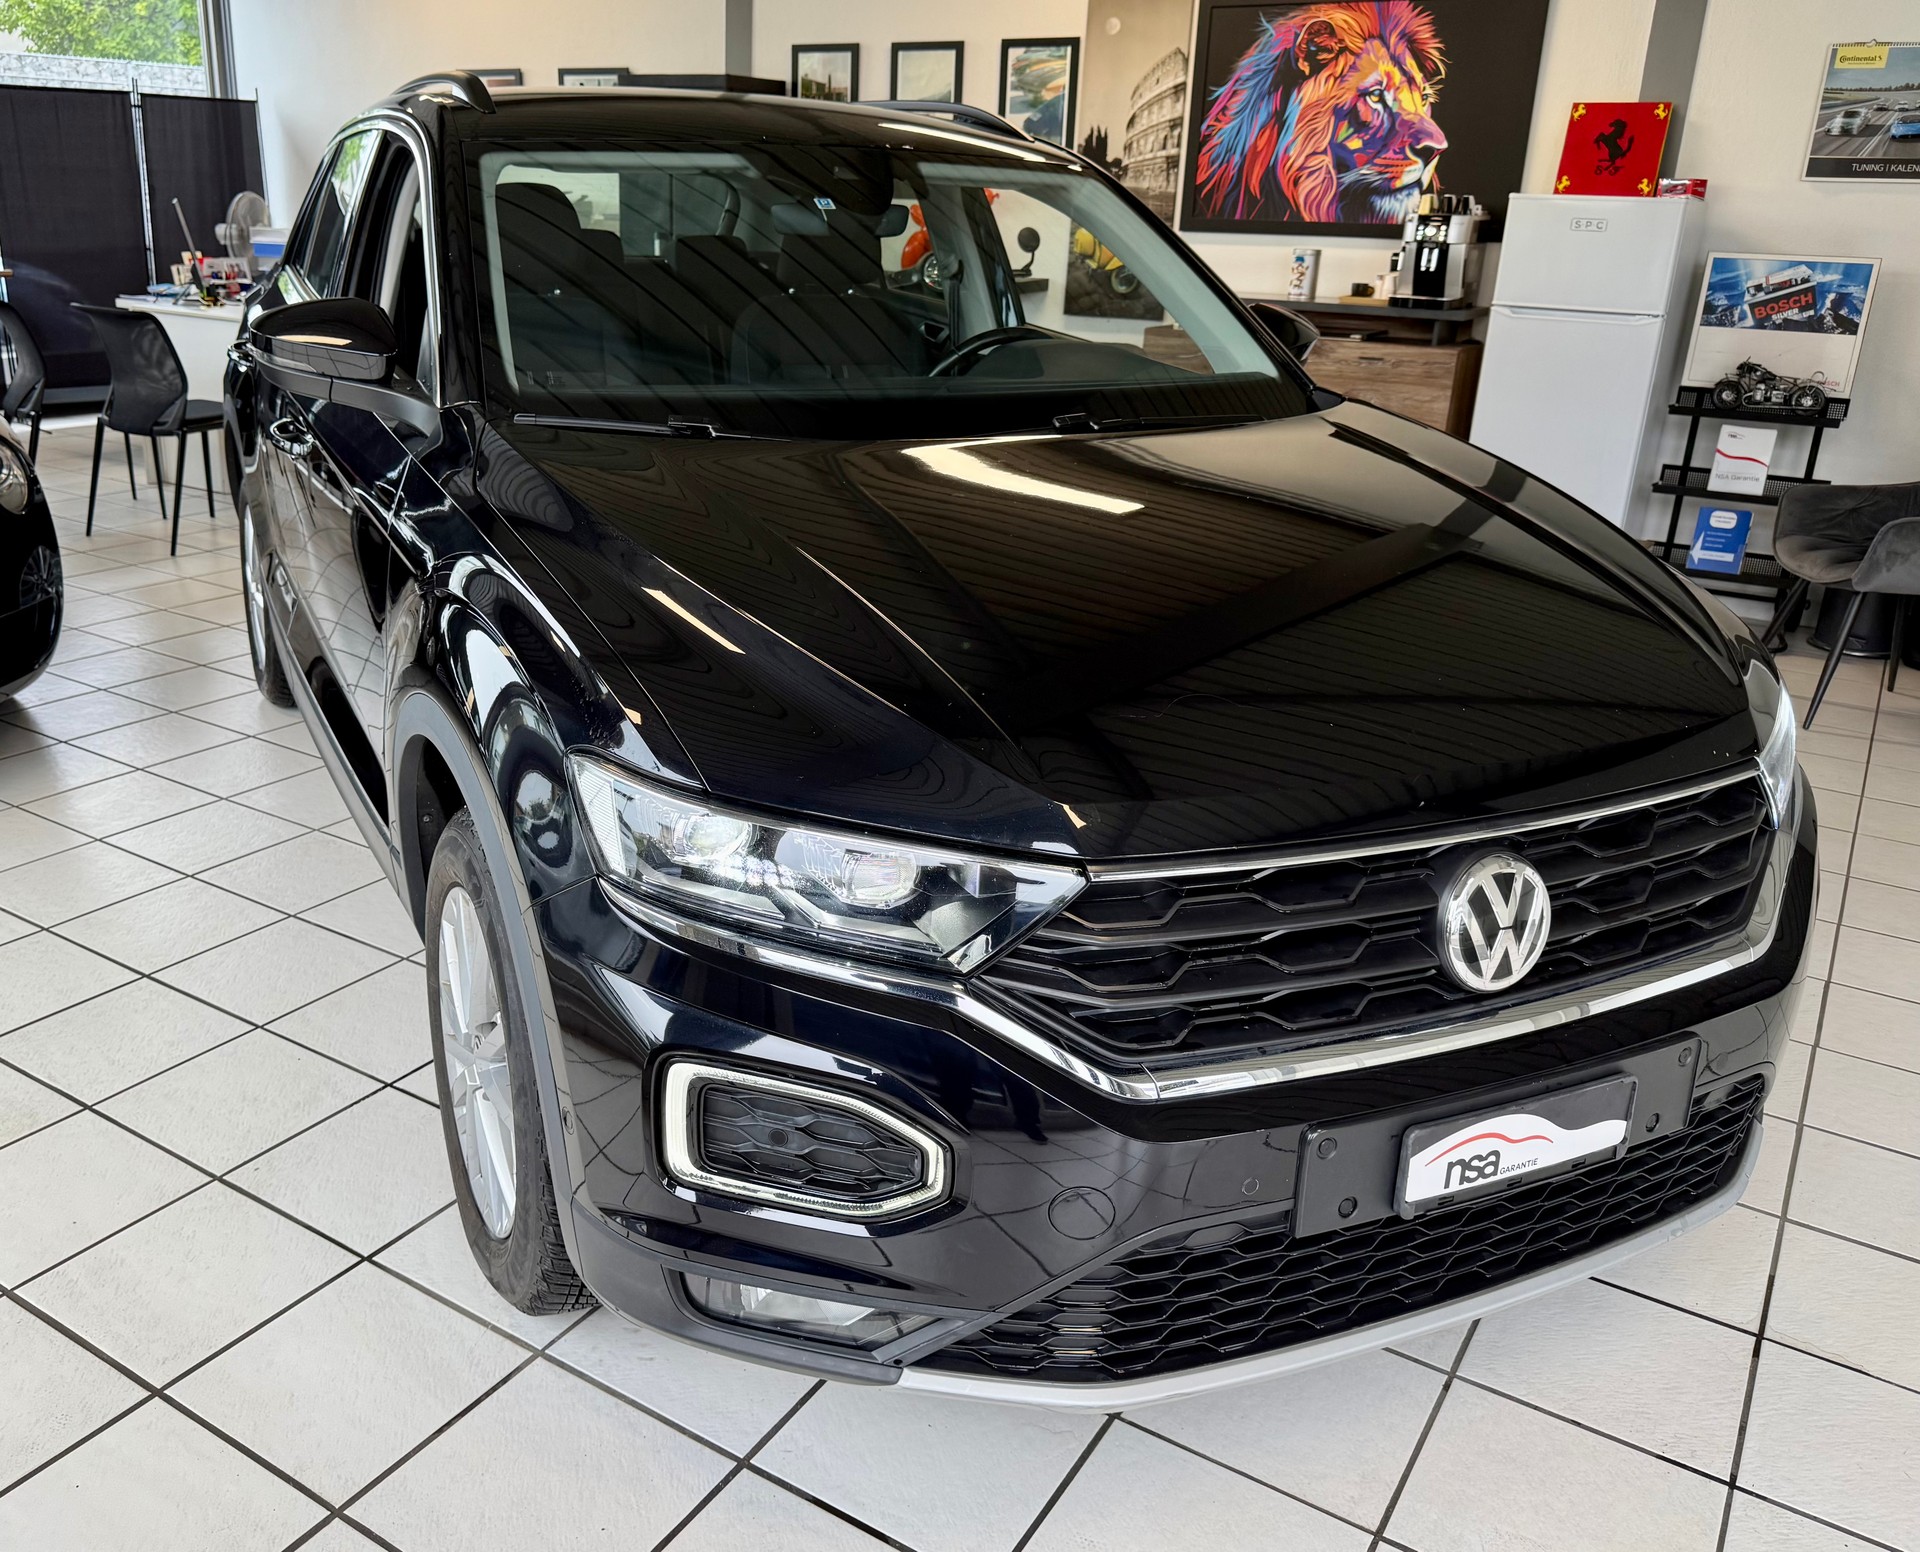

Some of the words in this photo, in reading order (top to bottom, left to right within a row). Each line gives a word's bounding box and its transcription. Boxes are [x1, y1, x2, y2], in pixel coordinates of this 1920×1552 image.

[1851, 163, 1884, 172] TUNING
[1890, 164, 1920, 173] KALEN
[1754, 292, 1813, 319] BOSCH
[1771, 308, 1799, 321] SILVER
[1443, 1149, 1501, 1190] nsa
[1499, 1158, 1539, 1175] GARANTIE
